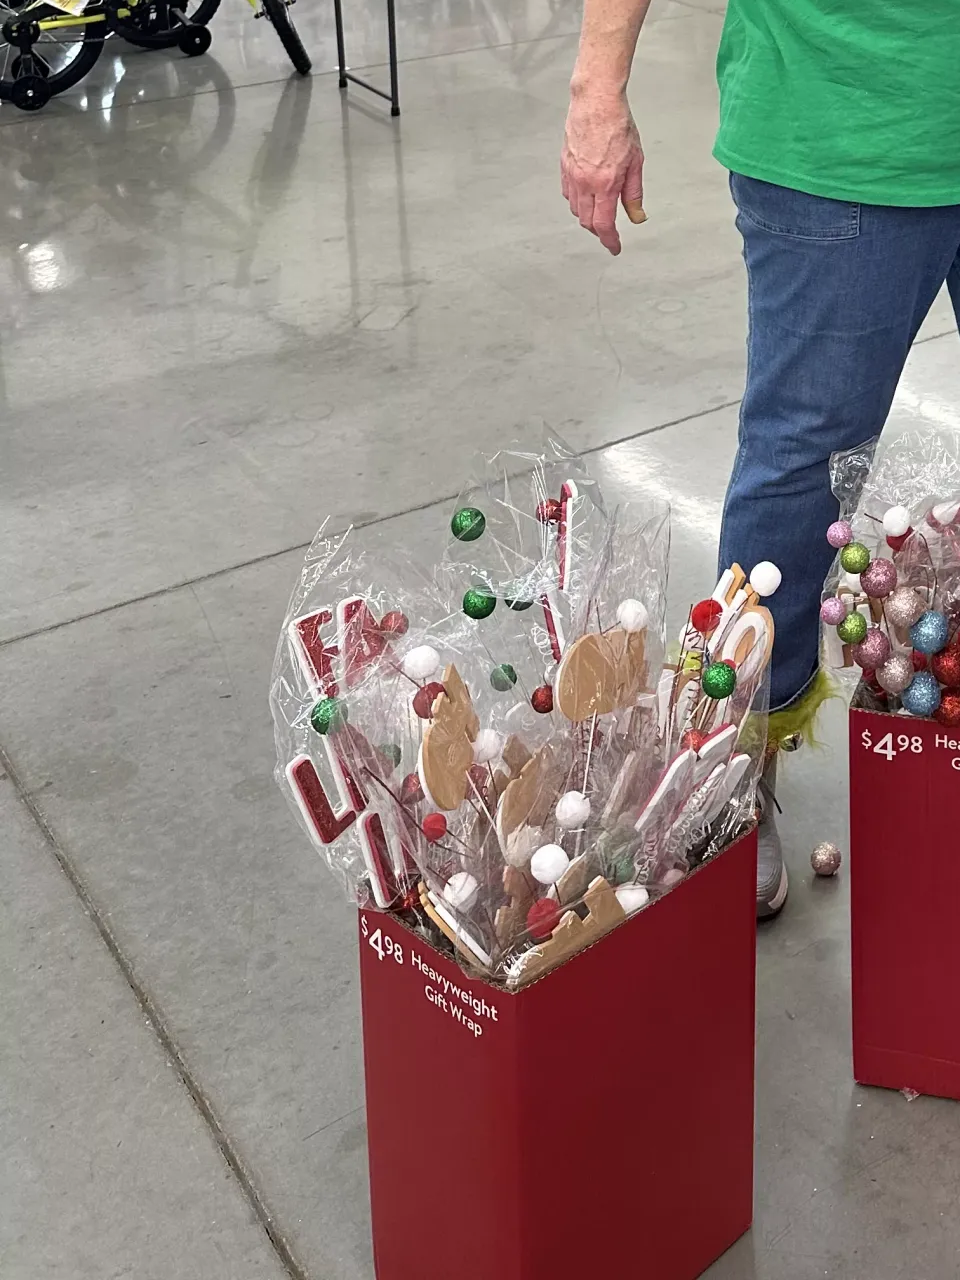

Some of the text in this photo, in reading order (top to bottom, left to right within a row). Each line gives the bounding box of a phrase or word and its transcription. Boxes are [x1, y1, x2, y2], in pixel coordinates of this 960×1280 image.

[411, 950, 499, 1022] Heavyweight
[424, 985, 483, 1037] Gift Wrap
